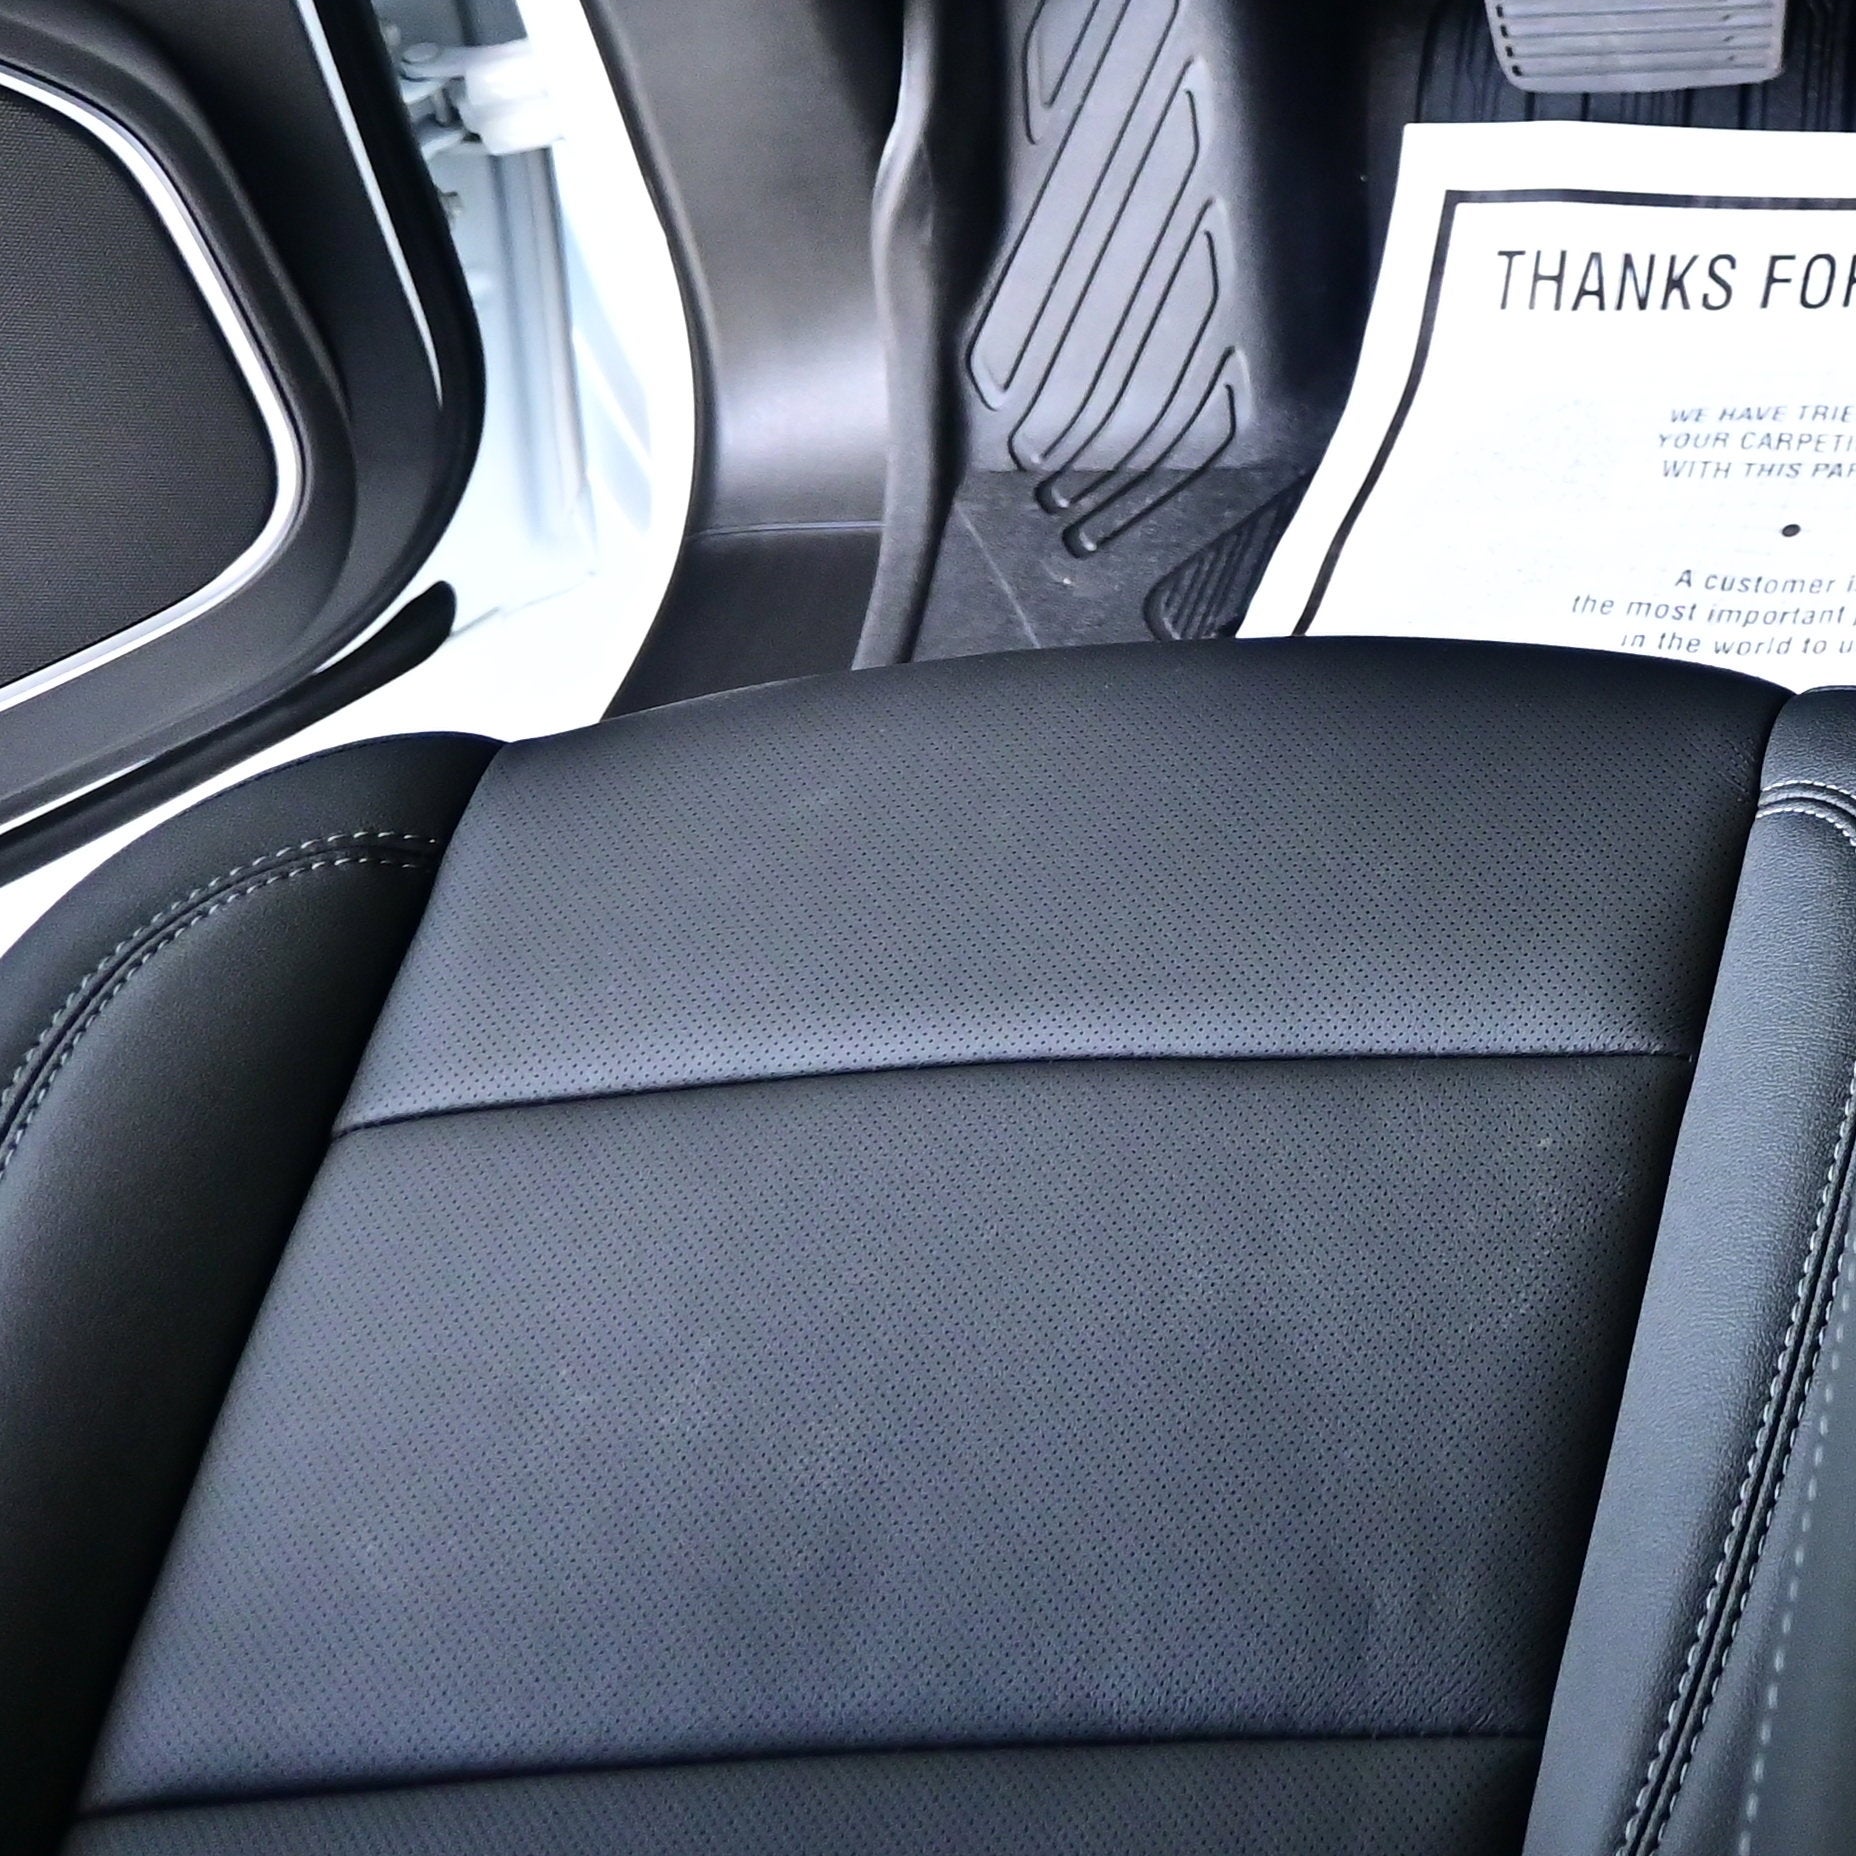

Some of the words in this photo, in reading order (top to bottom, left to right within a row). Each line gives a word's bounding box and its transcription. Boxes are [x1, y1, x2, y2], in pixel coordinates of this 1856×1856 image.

[1497, 249, 1738, 312] THANKS
[1669, 406, 1705, 424] WE
[1717, 405, 1788, 423] HAVE
[1657, 430, 1731, 450] YOUR
[1661, 459, 1733, 479] WITH
[1743, 461, 1803, 480] THIS
[1674, 568, 1693, 589] A
[1703, 572, 1836, 595] customer
[1571, 593, 1615, 616] the
[1626, 599, 1698, 622] most
[1706, 602, 1846, 628] important
[1620, 633, 1647, 649] in
[1657, 631, 1702, 654] the
[1713, 635, 1794, 657] world
[1801, 635, 1828, 656] to
